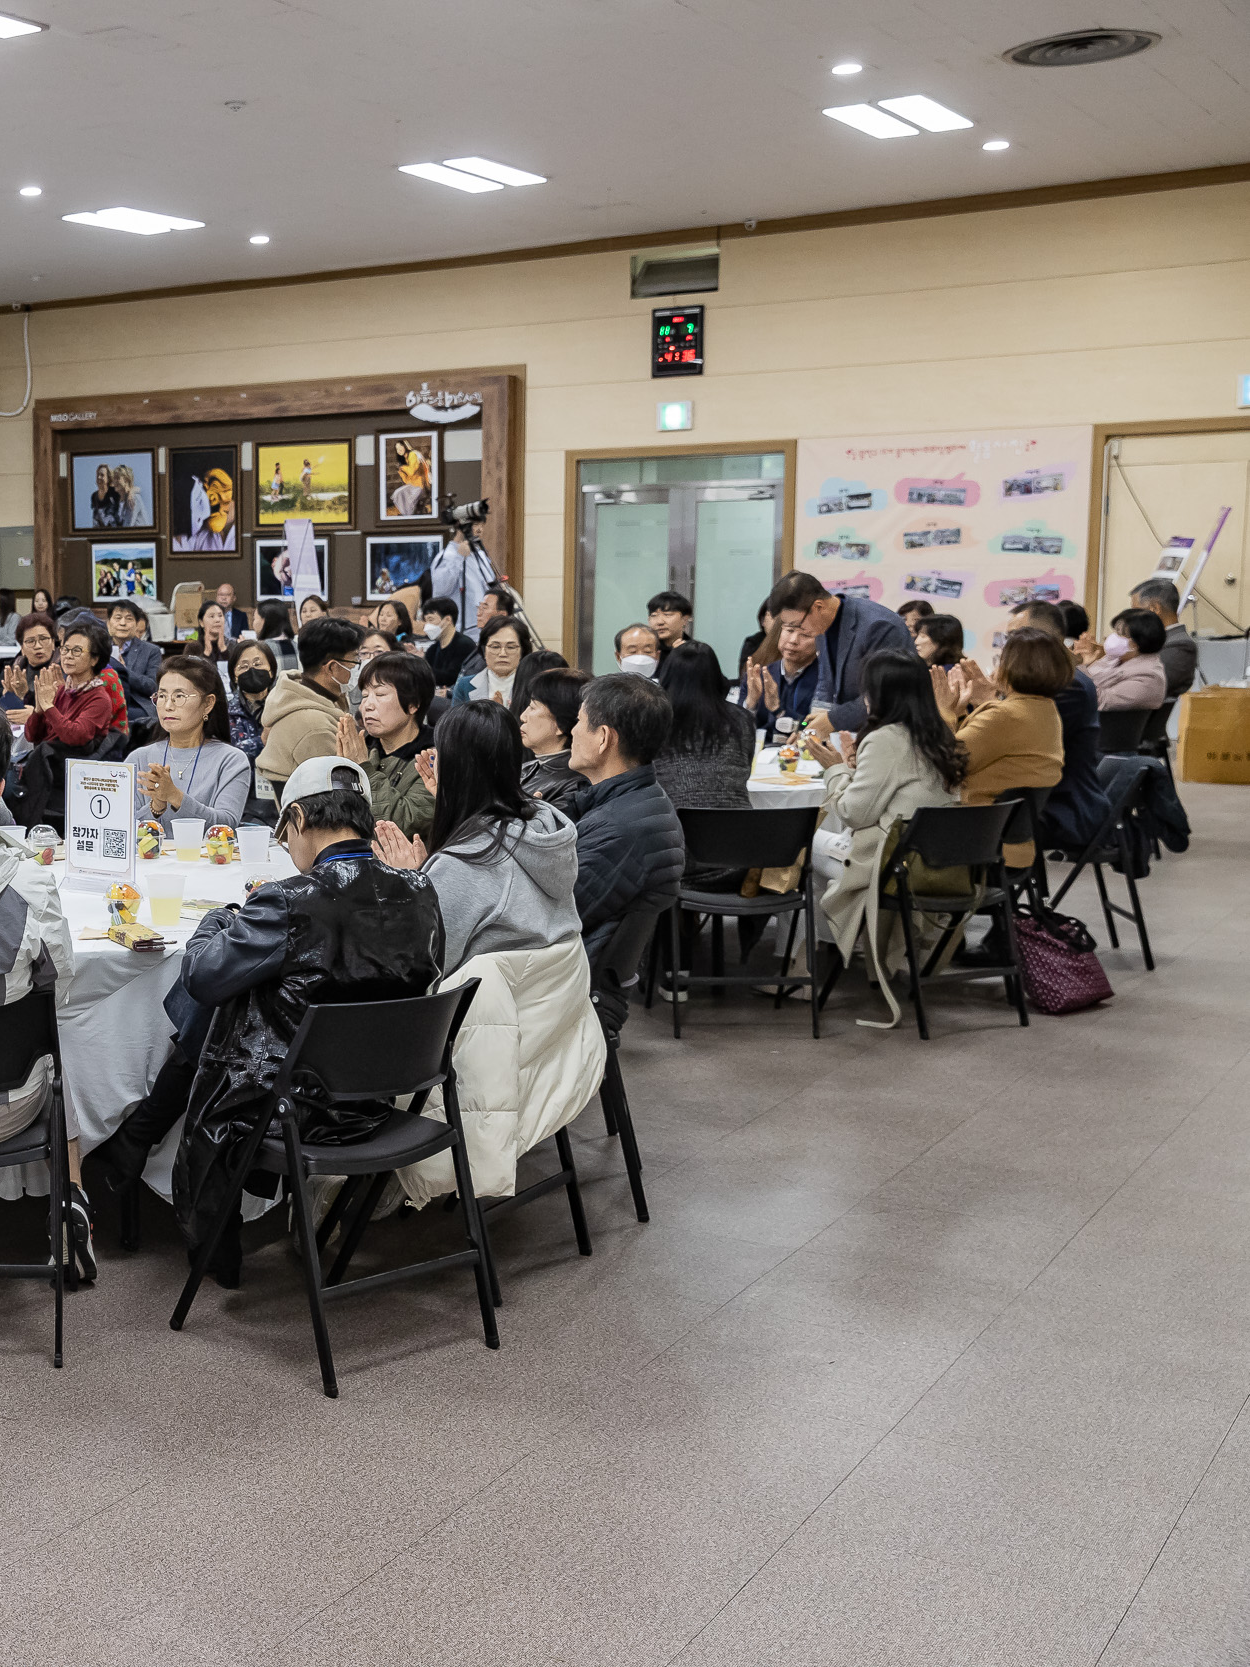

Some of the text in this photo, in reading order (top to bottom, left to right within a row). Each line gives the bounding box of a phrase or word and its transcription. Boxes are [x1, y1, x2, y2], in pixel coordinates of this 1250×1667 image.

[69, 411, 97, 421] GALLERY
[72, 826, 99, 840] 참가자
[76, 839, 94, 852] 설문
